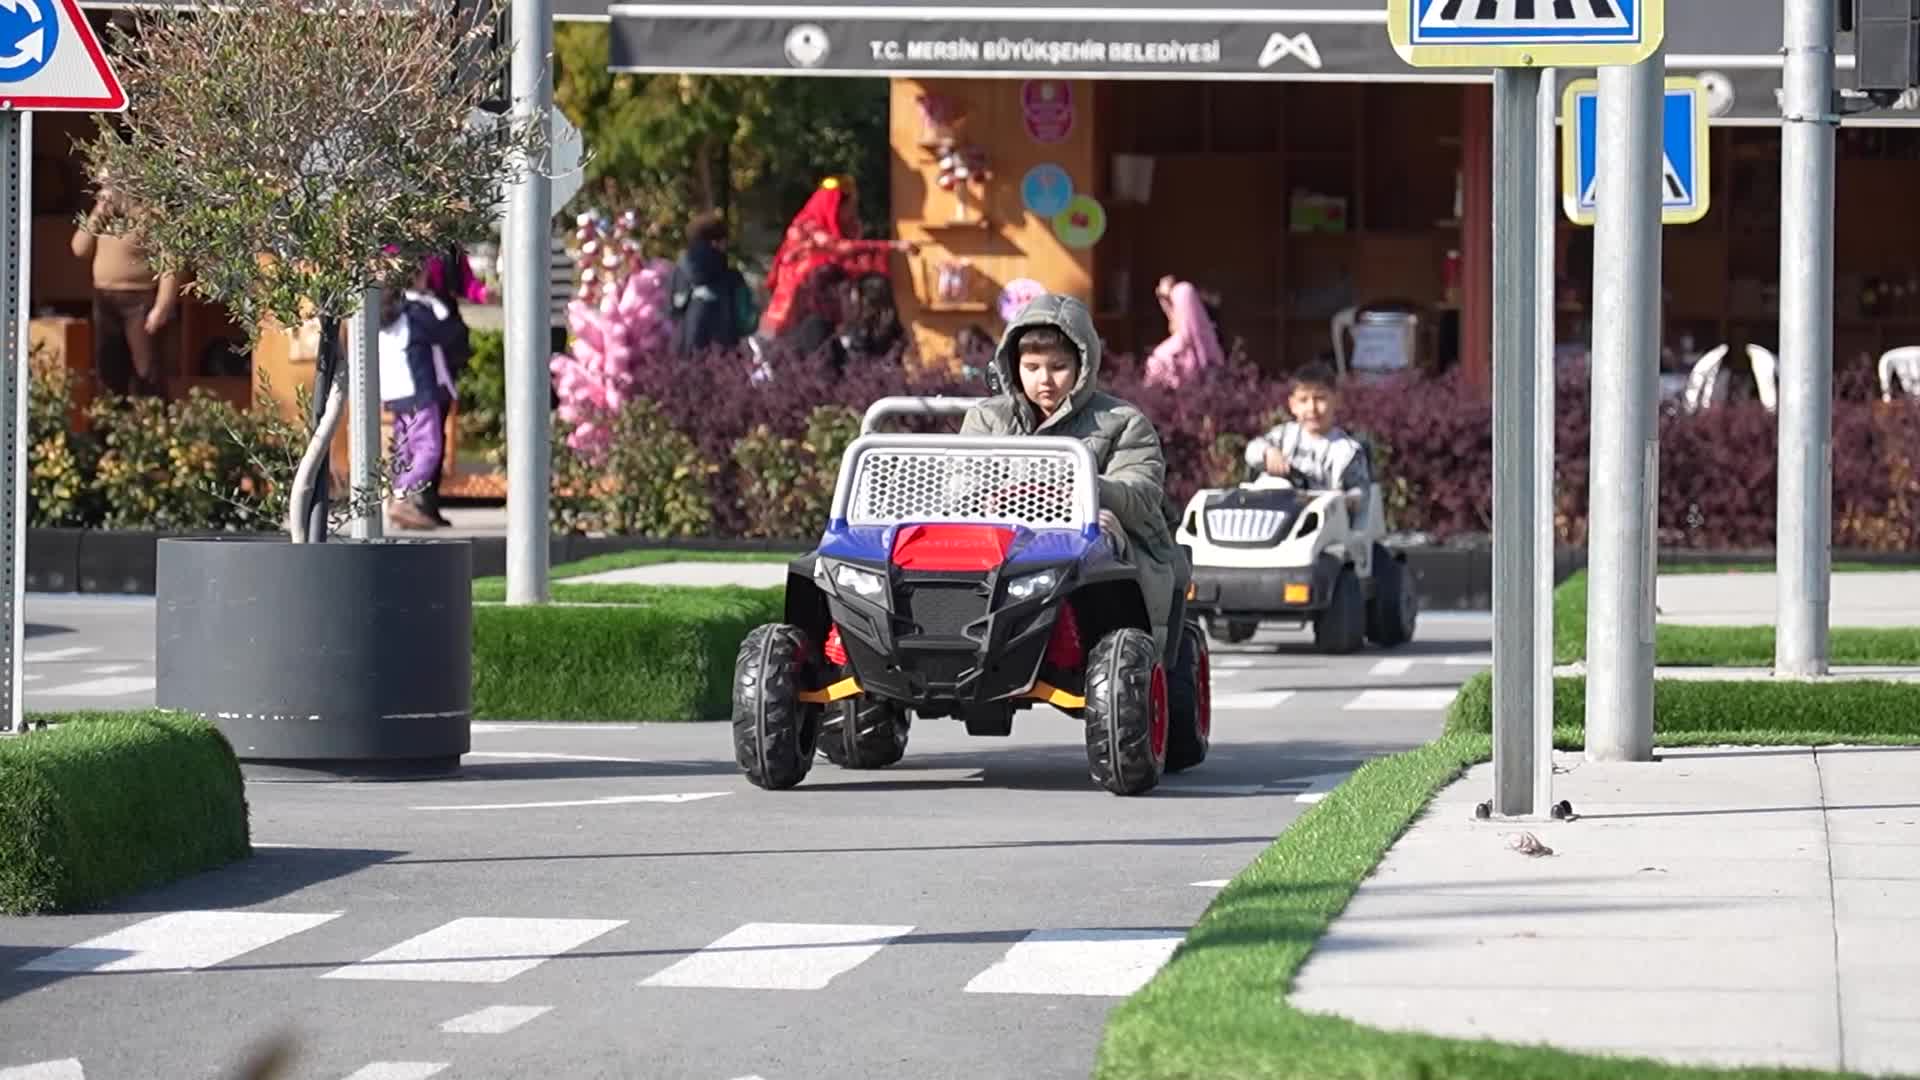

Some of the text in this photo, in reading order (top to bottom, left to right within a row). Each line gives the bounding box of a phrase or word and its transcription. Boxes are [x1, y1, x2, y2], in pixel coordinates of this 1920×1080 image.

[869, 37, 1221, 65] T.C. MERSİN BÜYÜKŞEHİR BELEDİYESİ
